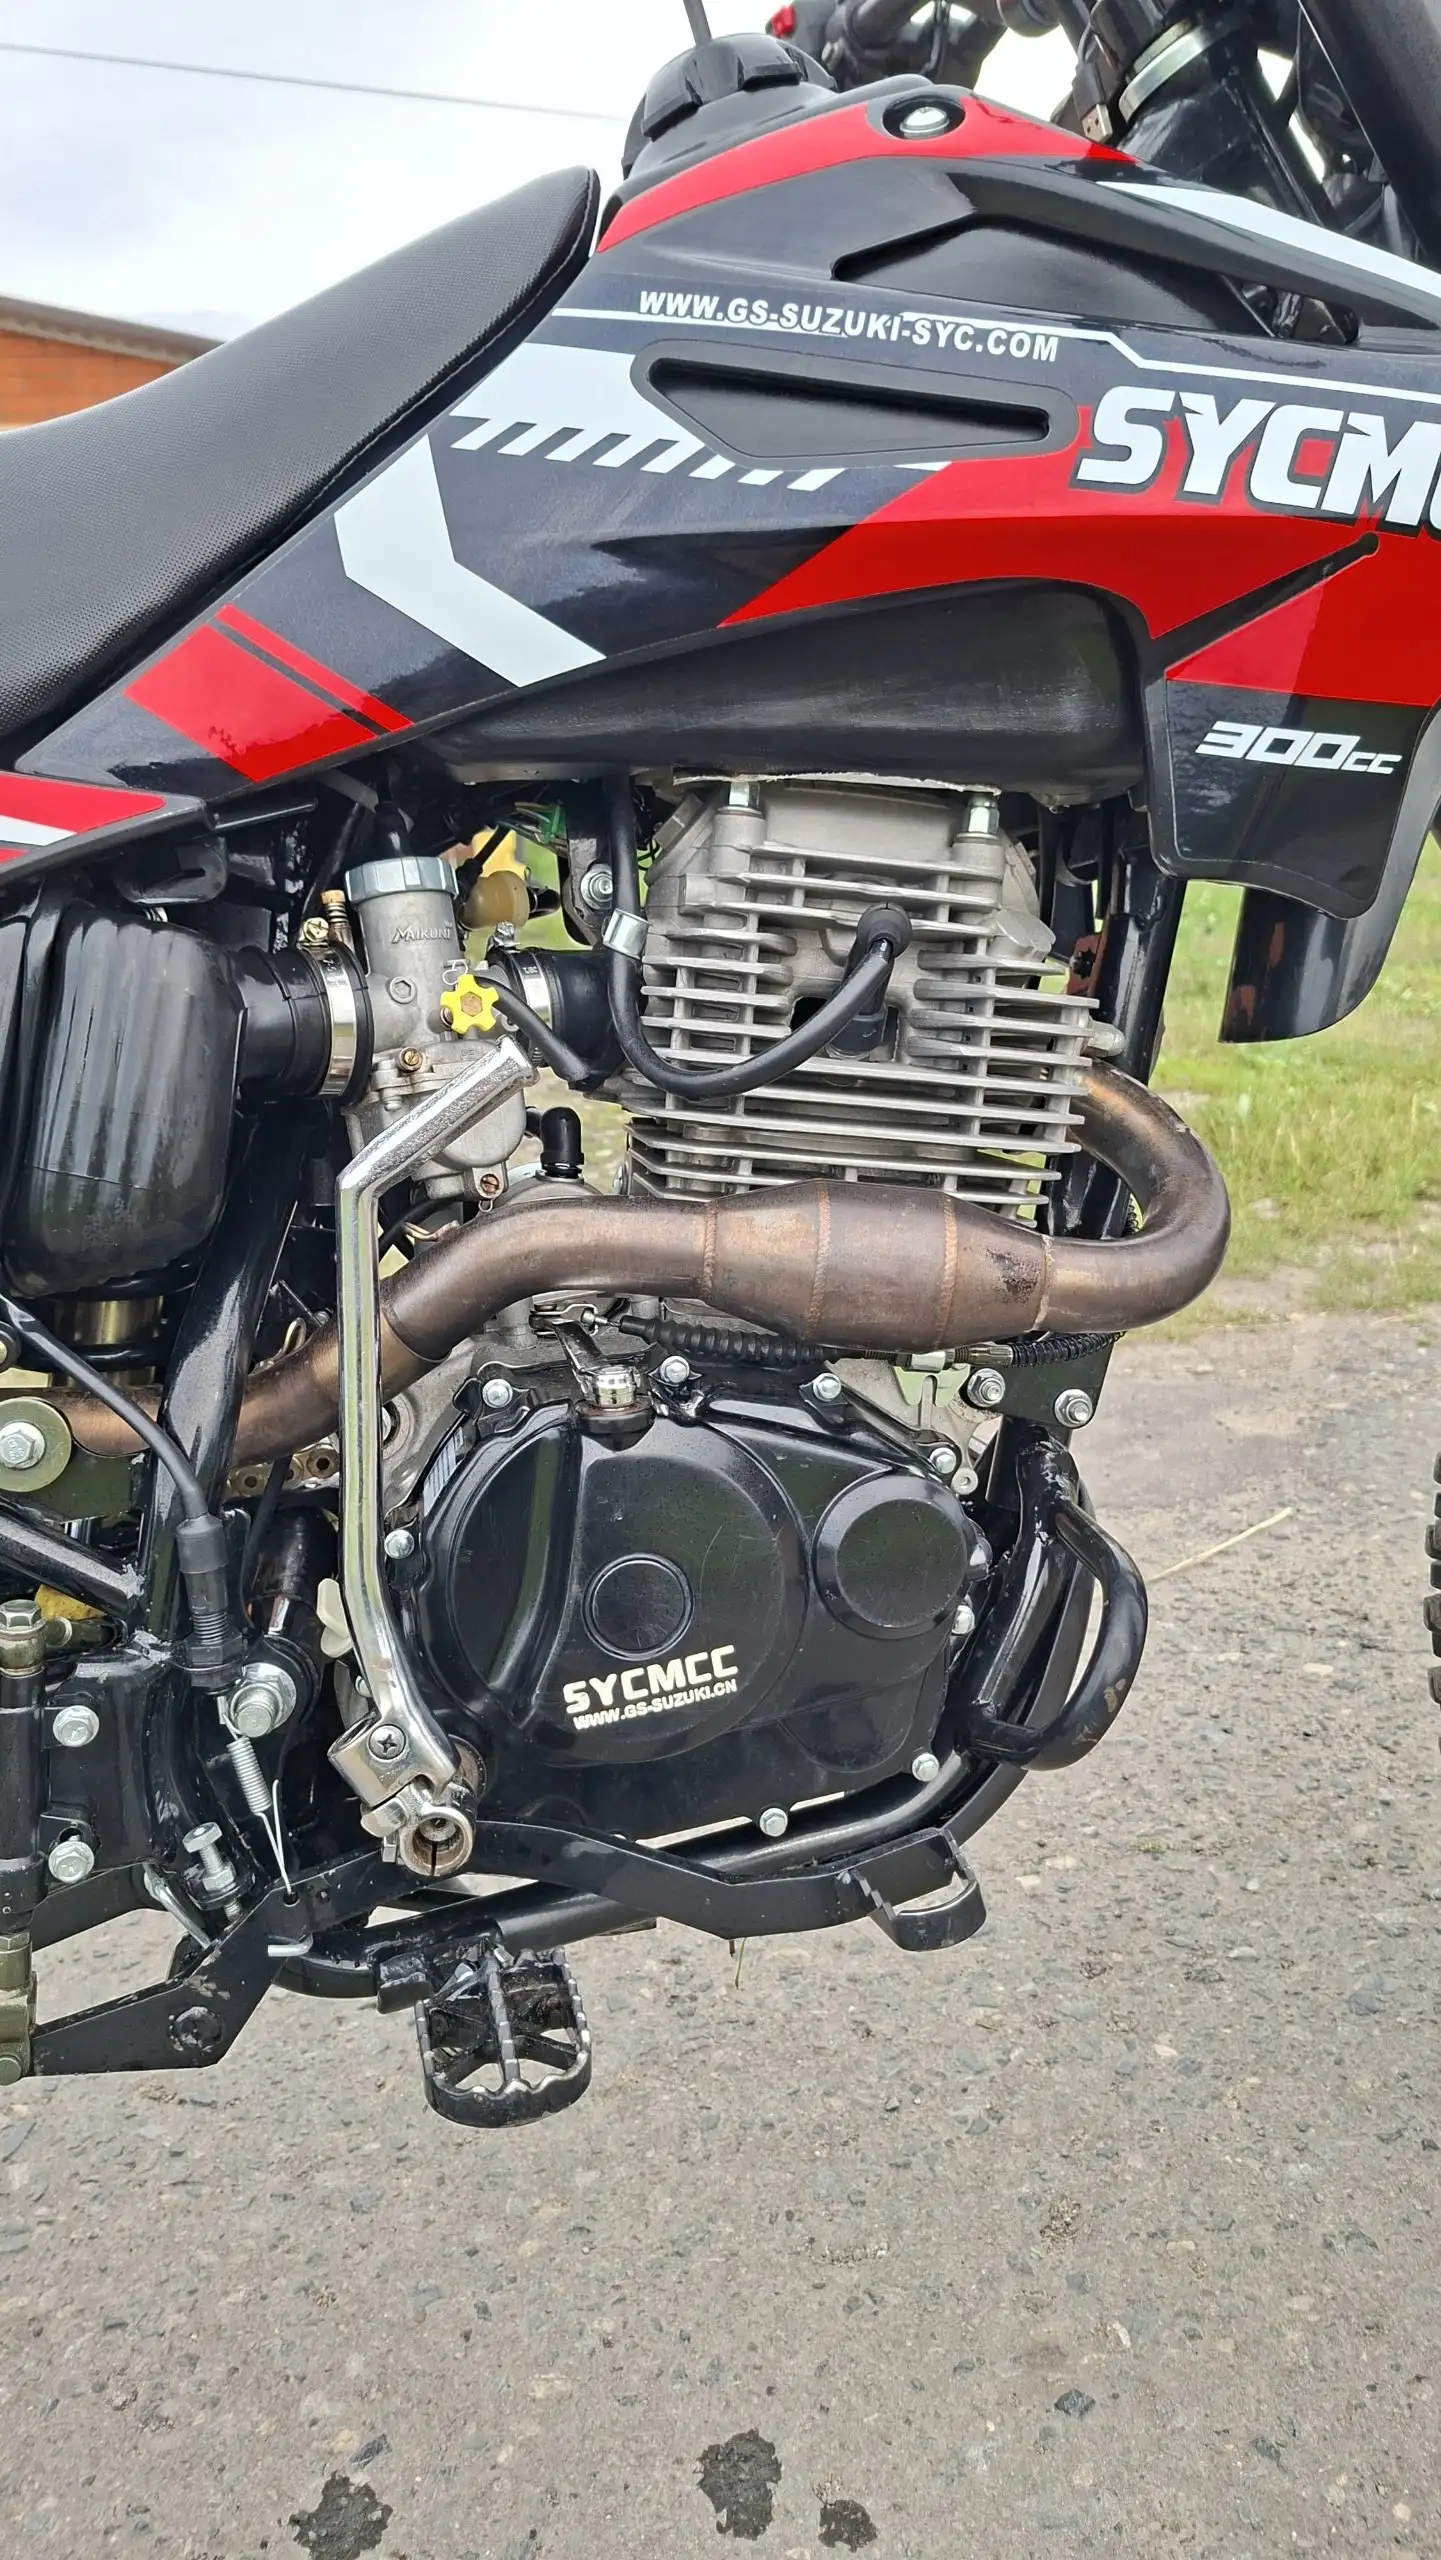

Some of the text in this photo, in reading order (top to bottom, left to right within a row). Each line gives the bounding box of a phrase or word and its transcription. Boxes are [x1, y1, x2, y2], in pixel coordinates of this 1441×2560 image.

[639, 290, 1059, 362] WWW.GS-SUZUKI-SYC.COM
[1076, 385, 1441, 530] SYCM
[562, 1644, 739, 1714] SYCMCC
[572, 1678, 738, 1730] WWW.GS-SUZUKI.CN
